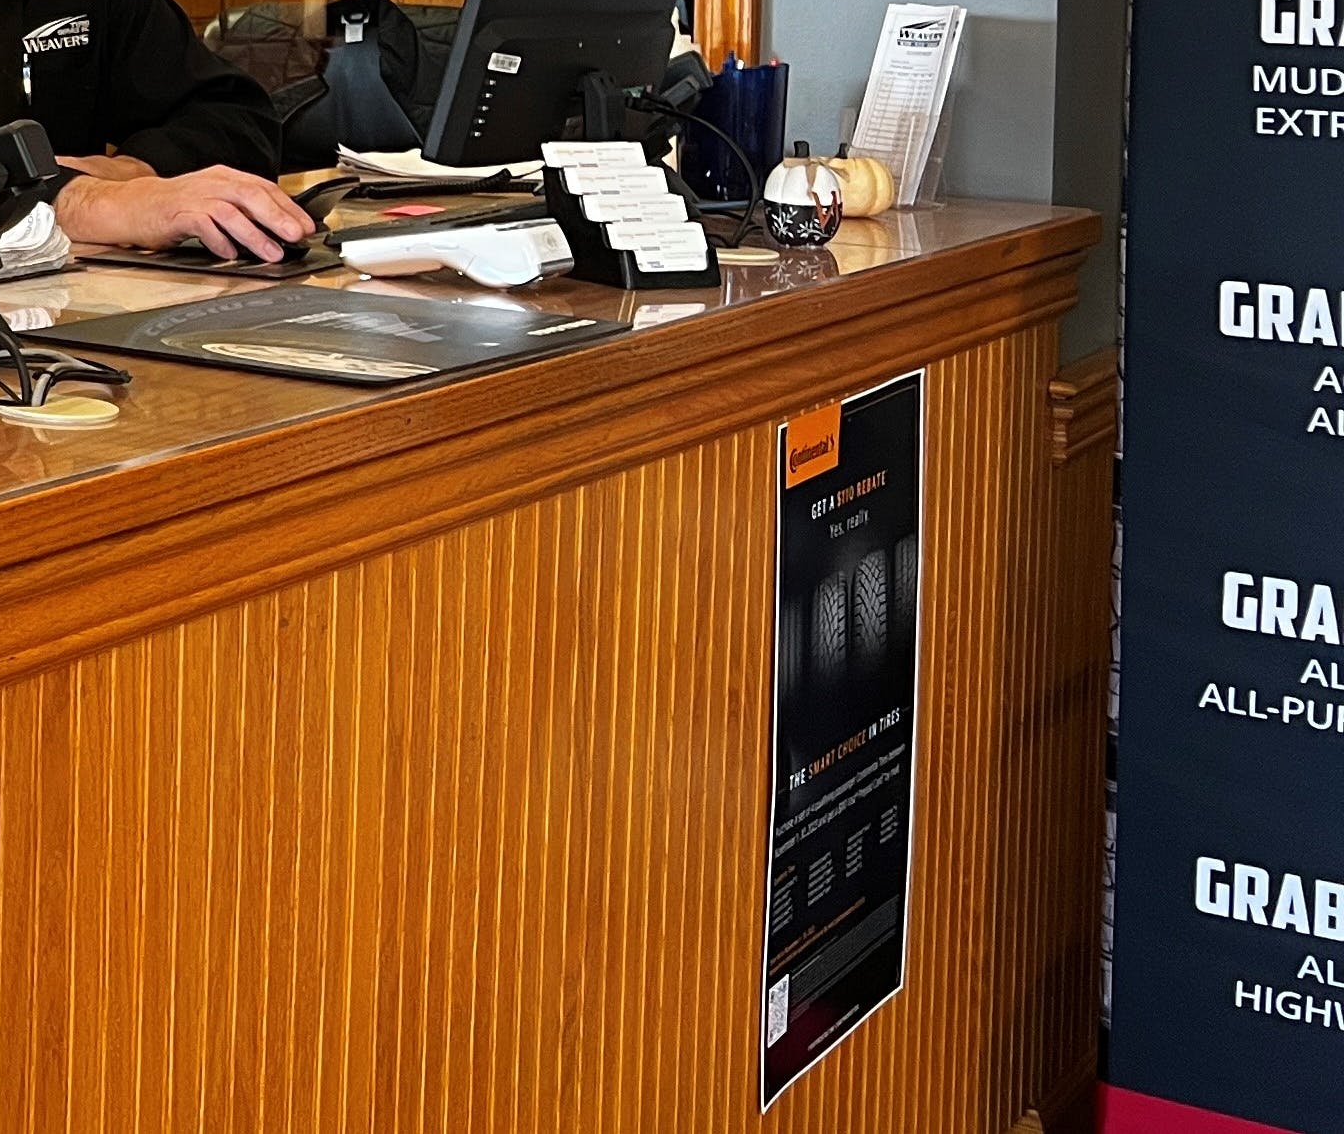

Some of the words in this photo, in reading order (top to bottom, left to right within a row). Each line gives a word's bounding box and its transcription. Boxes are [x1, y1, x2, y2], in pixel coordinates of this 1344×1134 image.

[1252, 65, 1344, 97] MUD
[1219, 280, 1344, 347] GRA
[1313, 366, 1344, 394] A
[811, 498, 827, 520] GET
[828, 494, 835, 512] A
[856, 469, 886, 498] REBATE
[1222, 571, 1344, 646] GRA
[789, 767, 807, 791] THE
[808, 748, 836, 780] SMART
[837, 728, 867, 760] CHOICE
[868, 722, 877, 740] IN
[879, 707, 900, 733] TIRES
[1195, 856, 1344, 942] GRAB
[1235, 980, 1344, 1031] HIGH
